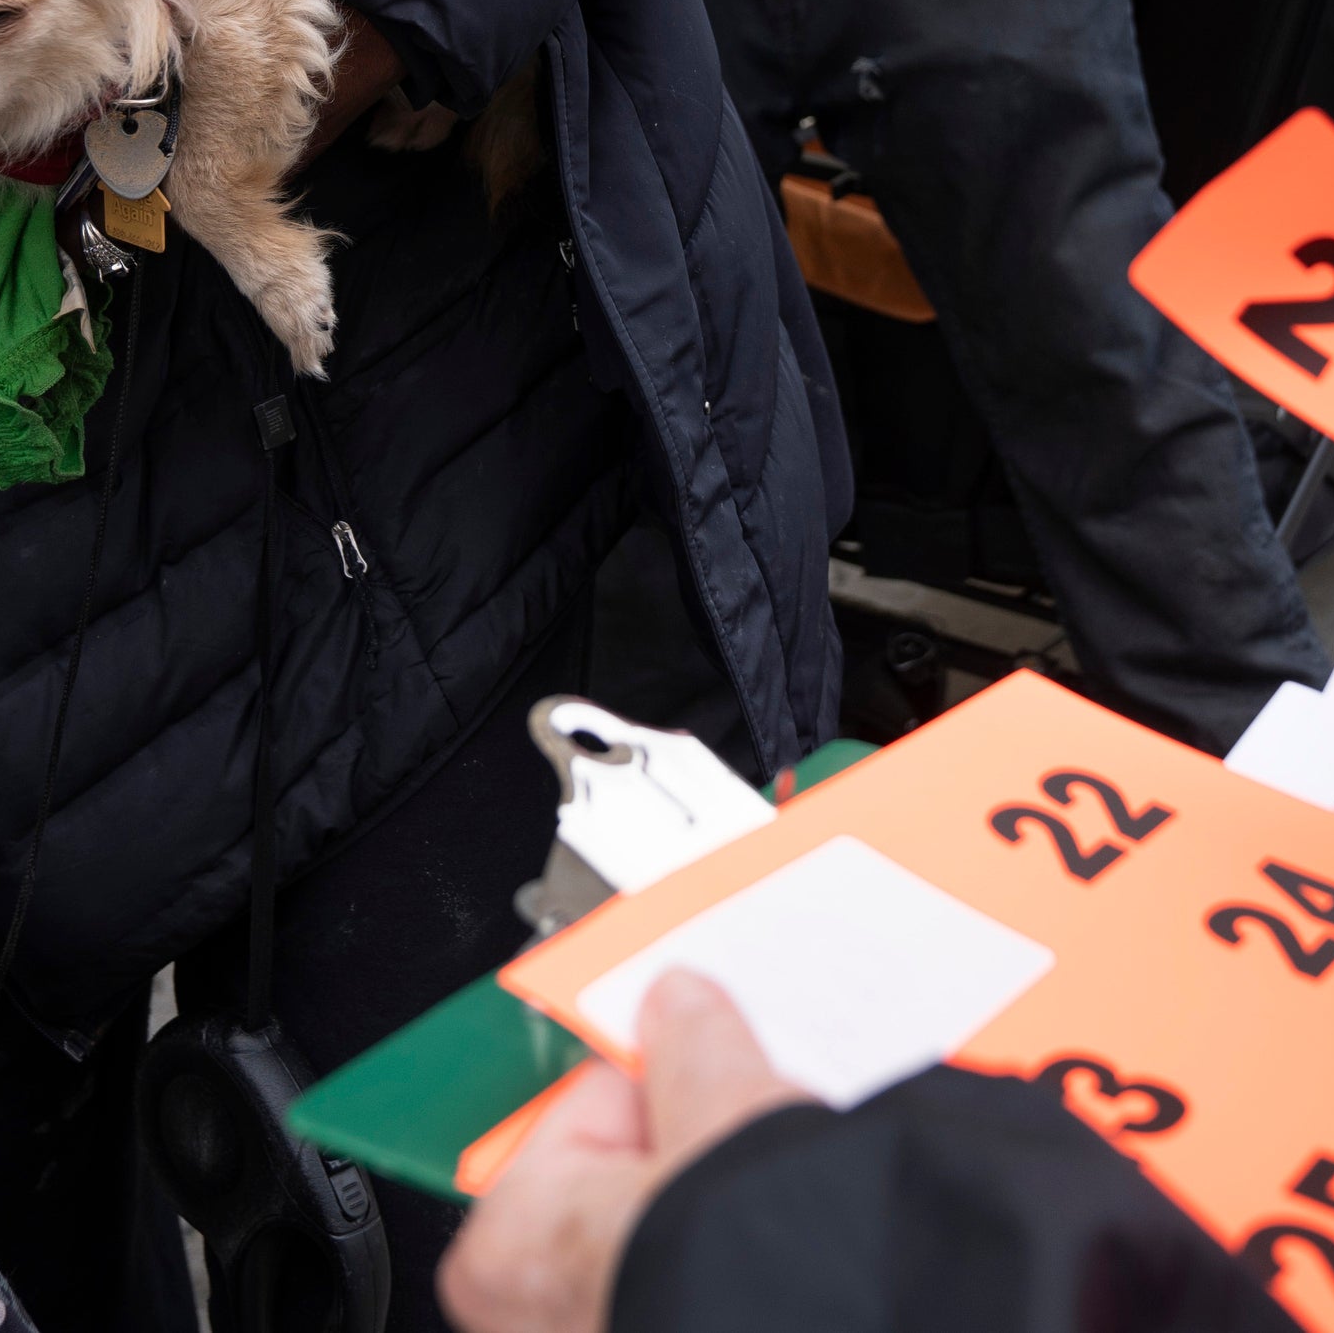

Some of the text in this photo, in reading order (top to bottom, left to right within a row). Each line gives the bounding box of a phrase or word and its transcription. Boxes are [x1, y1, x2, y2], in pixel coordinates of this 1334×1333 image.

[113, 199, 154, 227] Again
[992, 773, 1172, 880] 22
[1035, 1059, 1185, 1133] 3
